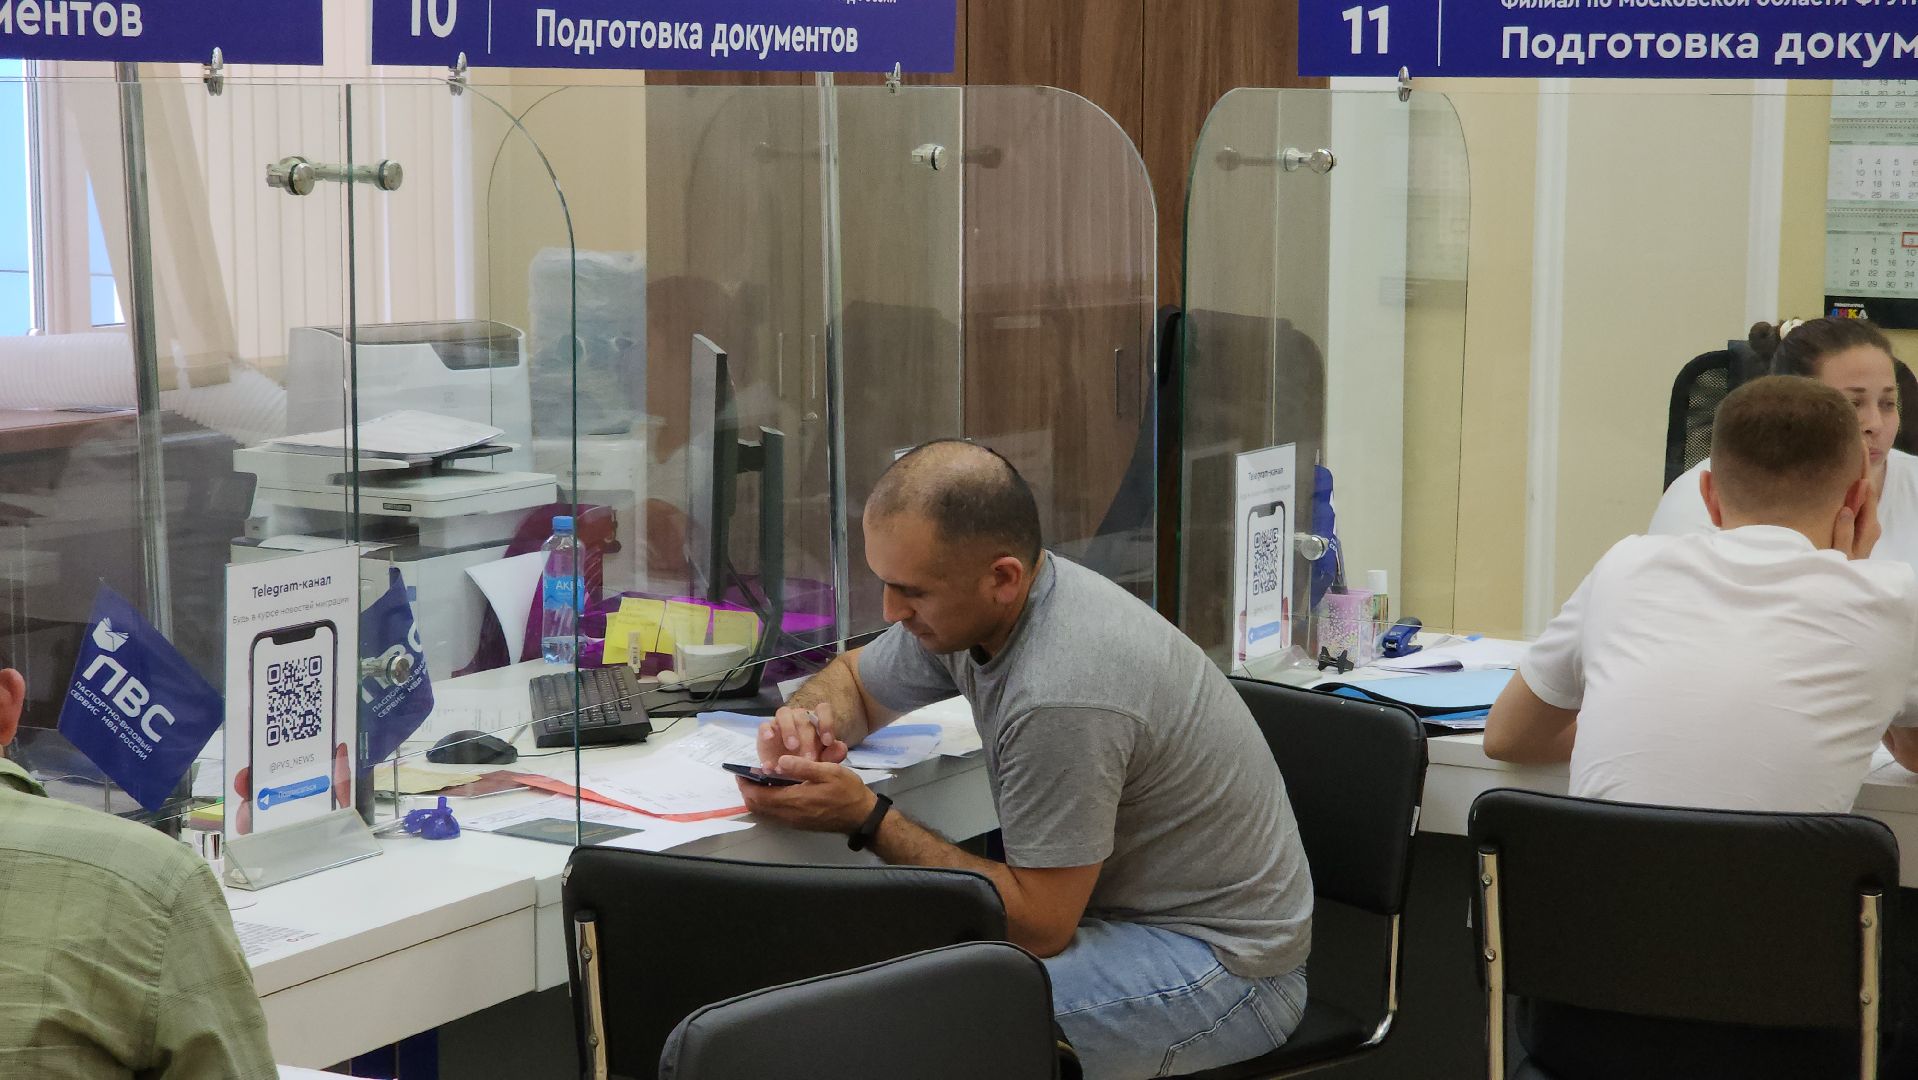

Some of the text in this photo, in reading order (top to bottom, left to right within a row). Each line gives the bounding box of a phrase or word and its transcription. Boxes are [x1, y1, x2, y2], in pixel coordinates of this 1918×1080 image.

[411, 0, 457, 38] 10
[536, 8, 859, 60] Подготовка документов
[1342, 6, 1389, 54] 11
[1502, 26, 1918, 68] Подготовка докум
[251, 575, 332, 599] Telegram-канал
[258, 609, 280, 621] курсе
[281, 600, 314, 614] новостей
[74, 681, 153, 754] ПАСПОРТНО-ВИЗОВЫЙ
[82, 654, 176, 743] ПВС
[70, 689, 148, 761] СЕРВИС МВД РОССИИ
